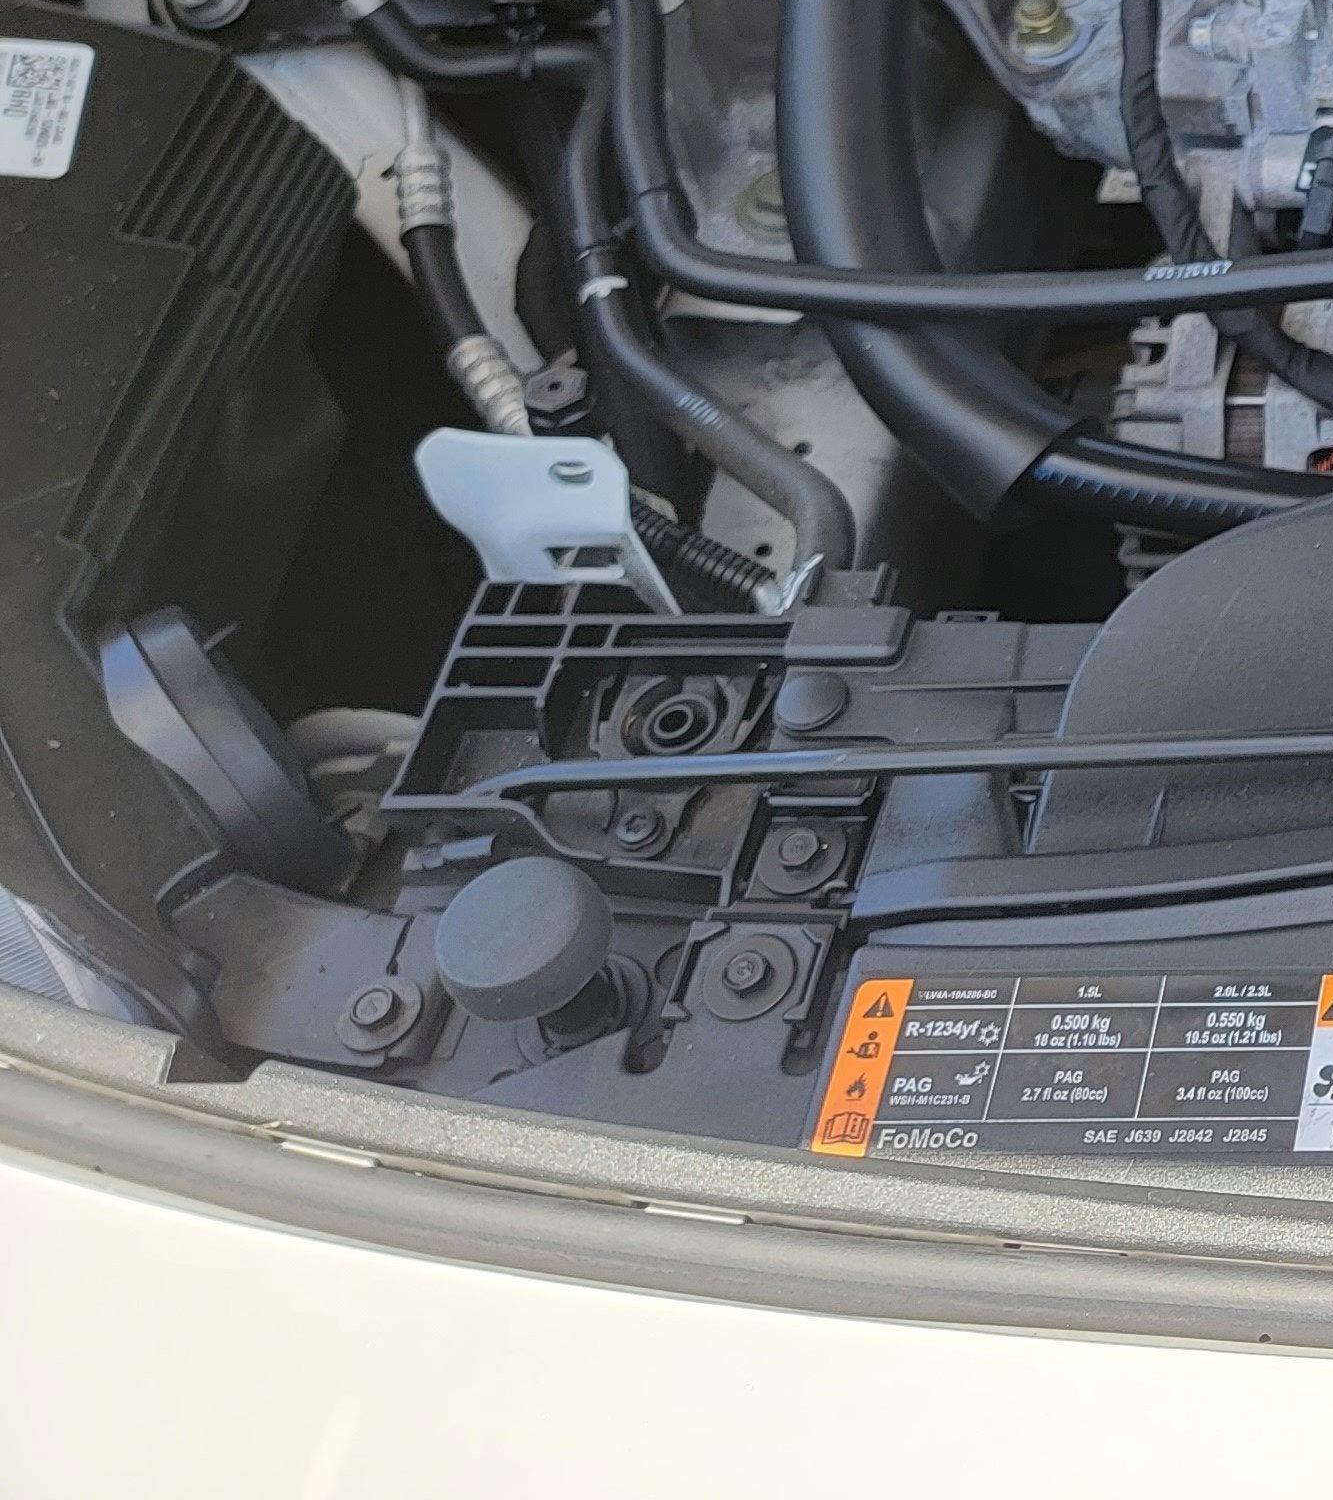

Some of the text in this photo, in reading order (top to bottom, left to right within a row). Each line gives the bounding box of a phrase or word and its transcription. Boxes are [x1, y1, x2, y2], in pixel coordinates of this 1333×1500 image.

[1077, 985, 1102, 999] 1.5L
[1213, 985, 1239, 998] 2.0L
[1247, 985, 1272, 998] 2.3L
[1051, 1014, 1112, 1033] 0.500 kg
[1205, 1011, 1266, 1030] 0.550 kg
[904, 1020, 981, 1040] R-1234yf
[1184, 1029, 1282, 1046] 19.5 oz (1.21 lbs)
[1034, 1032, 1121, 1049] 18 oz (1.10 lbs)
[892, 1077, 932, 1093] PAG
[1053, 1070, 1084, 1084] PAG
[1210, 1070, 1240, 1084] PAG
[1021, 1087, 1042, 1101] 2.7
[1053, 1089, 1069, 1101] oz
[1070, 1087, 1108, 1103] (80cc)
[1176, 1087, 1195, 1101] 3.4
[1207, 1089, 1223, 1100] oz
[1225, 1086, 1269, 1103] (100cc)
[876, 1128, 979, 1149] FoMoCo
[1083, 1128, 1268, 1144] SAE J639 J2842 J2845
